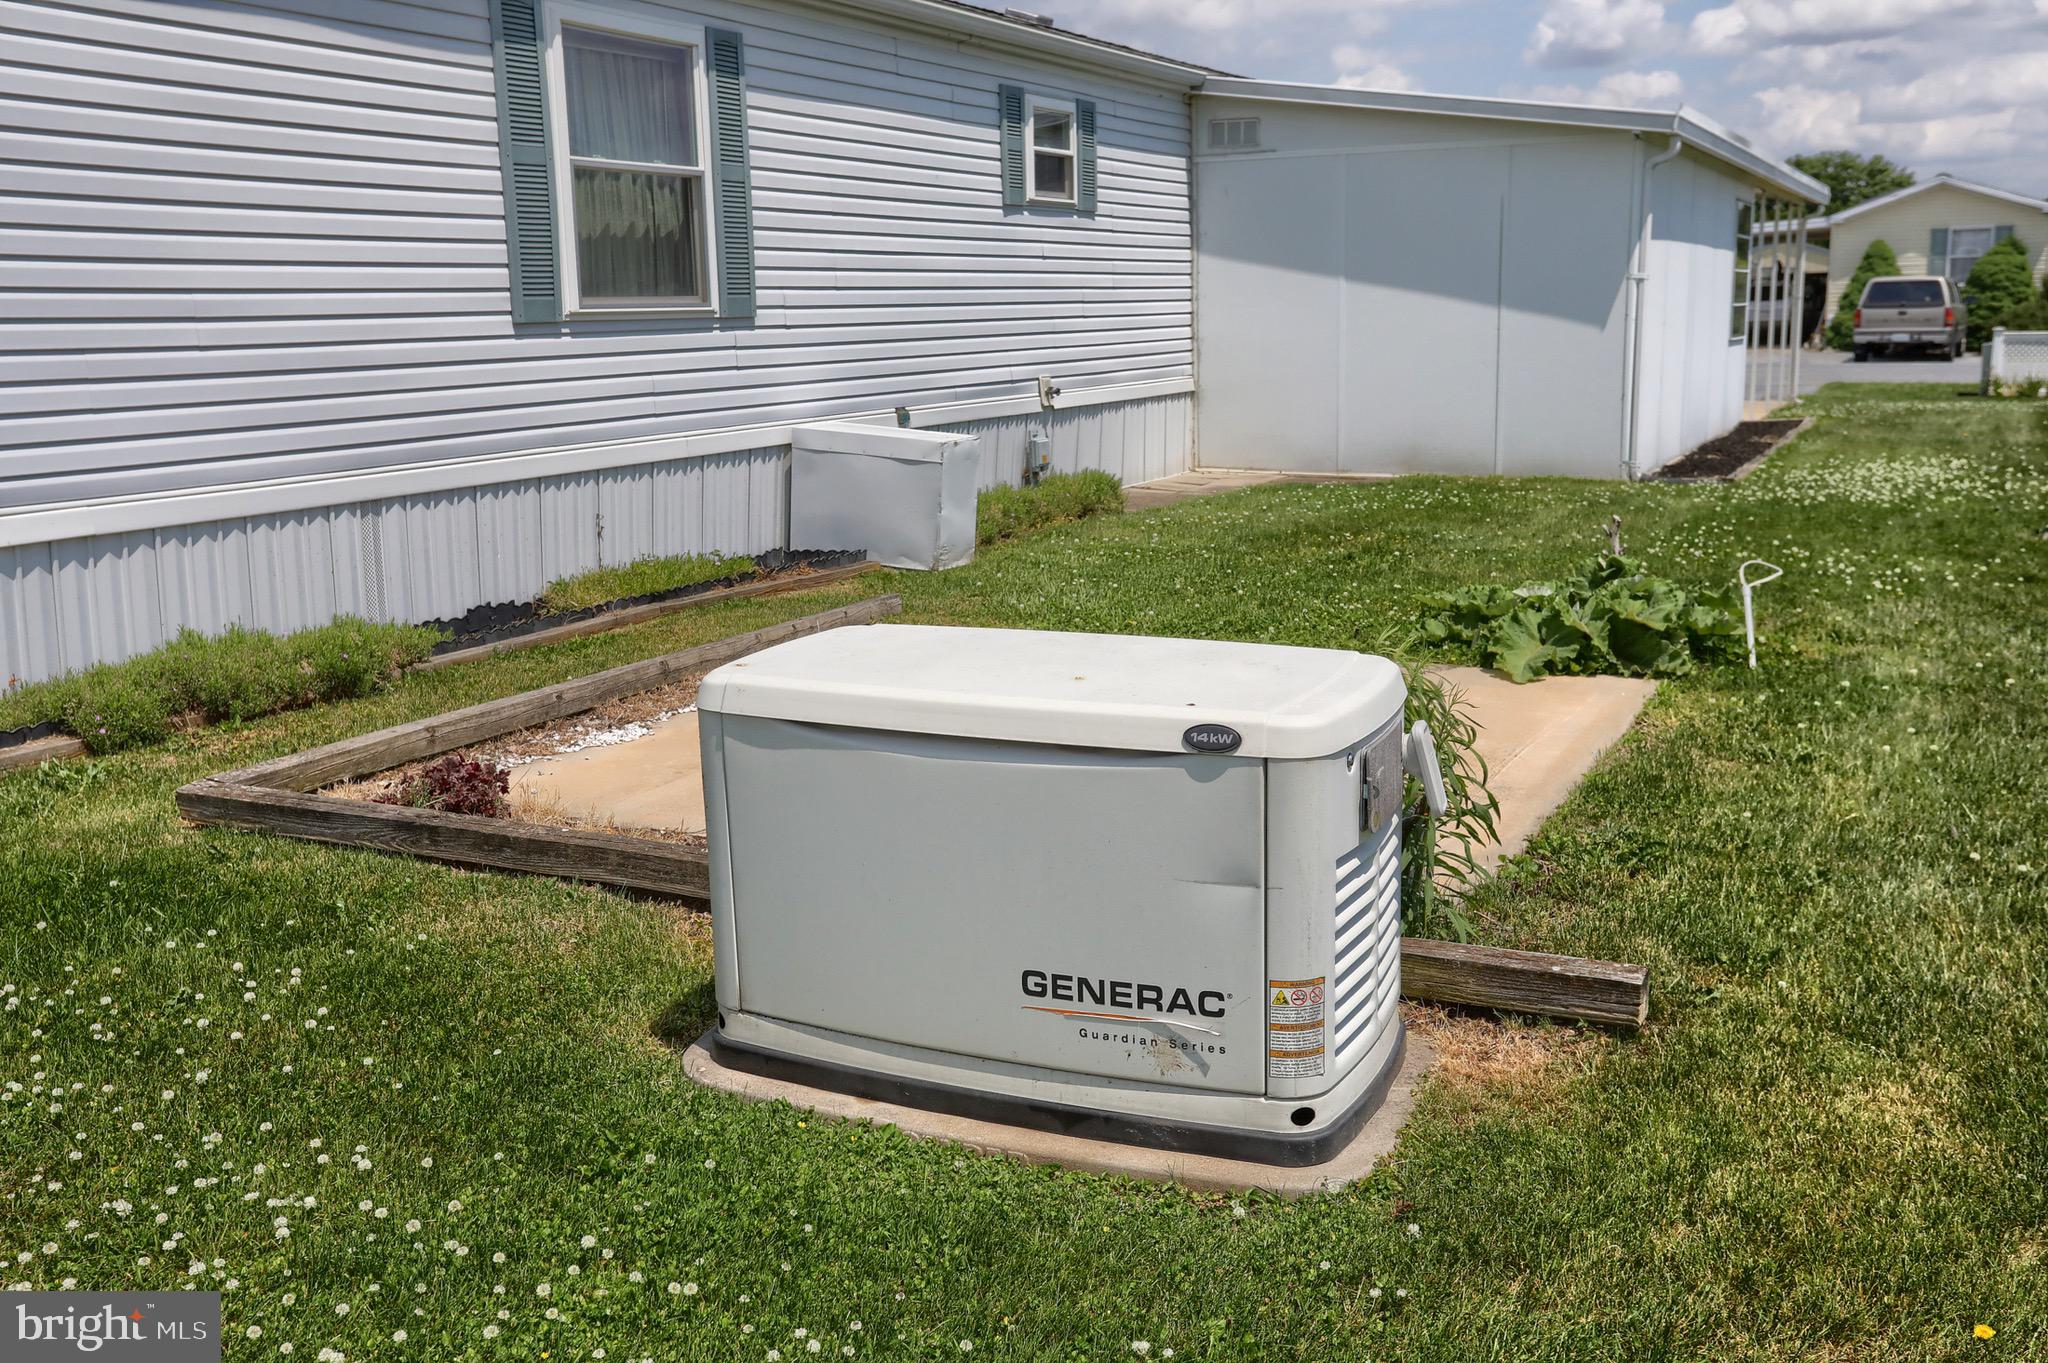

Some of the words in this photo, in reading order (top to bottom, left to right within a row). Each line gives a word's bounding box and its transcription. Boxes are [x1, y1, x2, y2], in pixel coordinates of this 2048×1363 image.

[1190, 732, 1233, 744] 14kW
[1021, 969, 1226, 1019] GENERAC
[1078, 1028, 1158, 1047] Guardian
[1169, 1038, 1227, 1055] Series
